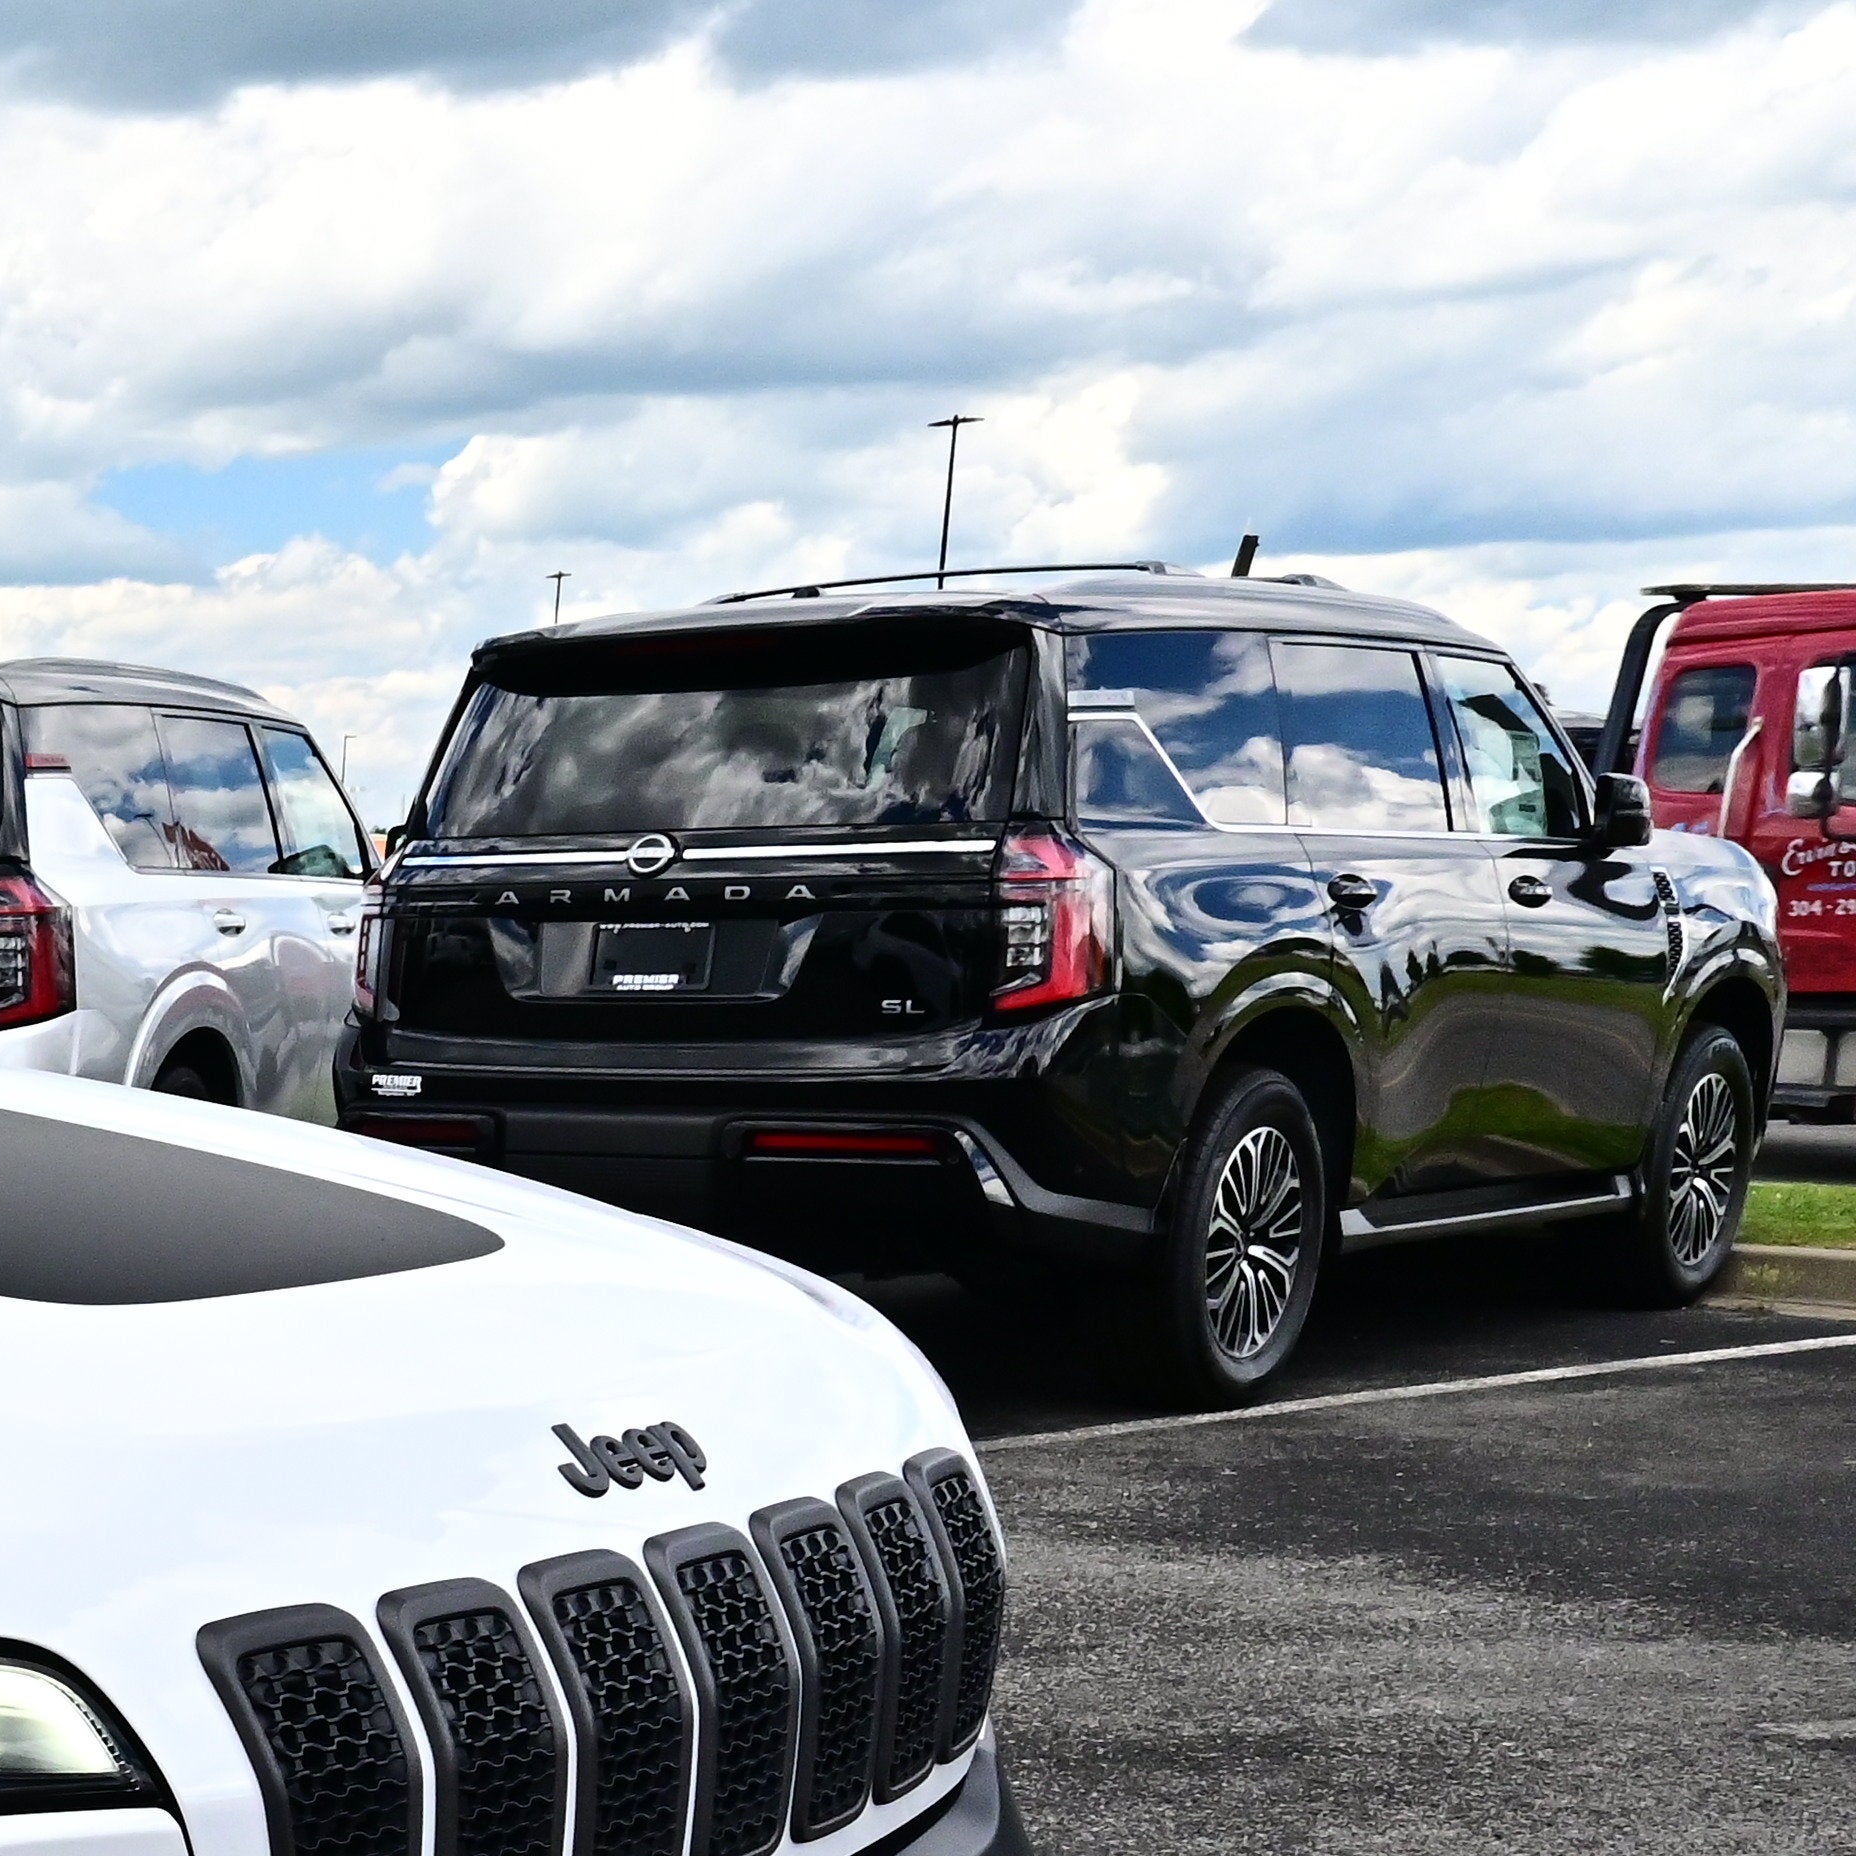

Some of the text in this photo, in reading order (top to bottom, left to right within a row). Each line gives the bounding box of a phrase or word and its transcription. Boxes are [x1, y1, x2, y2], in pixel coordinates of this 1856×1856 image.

[494, 884, 816, 906] ARMADA
[612, 974, 679, 985] PREMIER
[881, 999, 926, 1014] SL
[371, 1074, 422, 1088] PREMIER
[551, 1421, 707, 1499] Jeep
